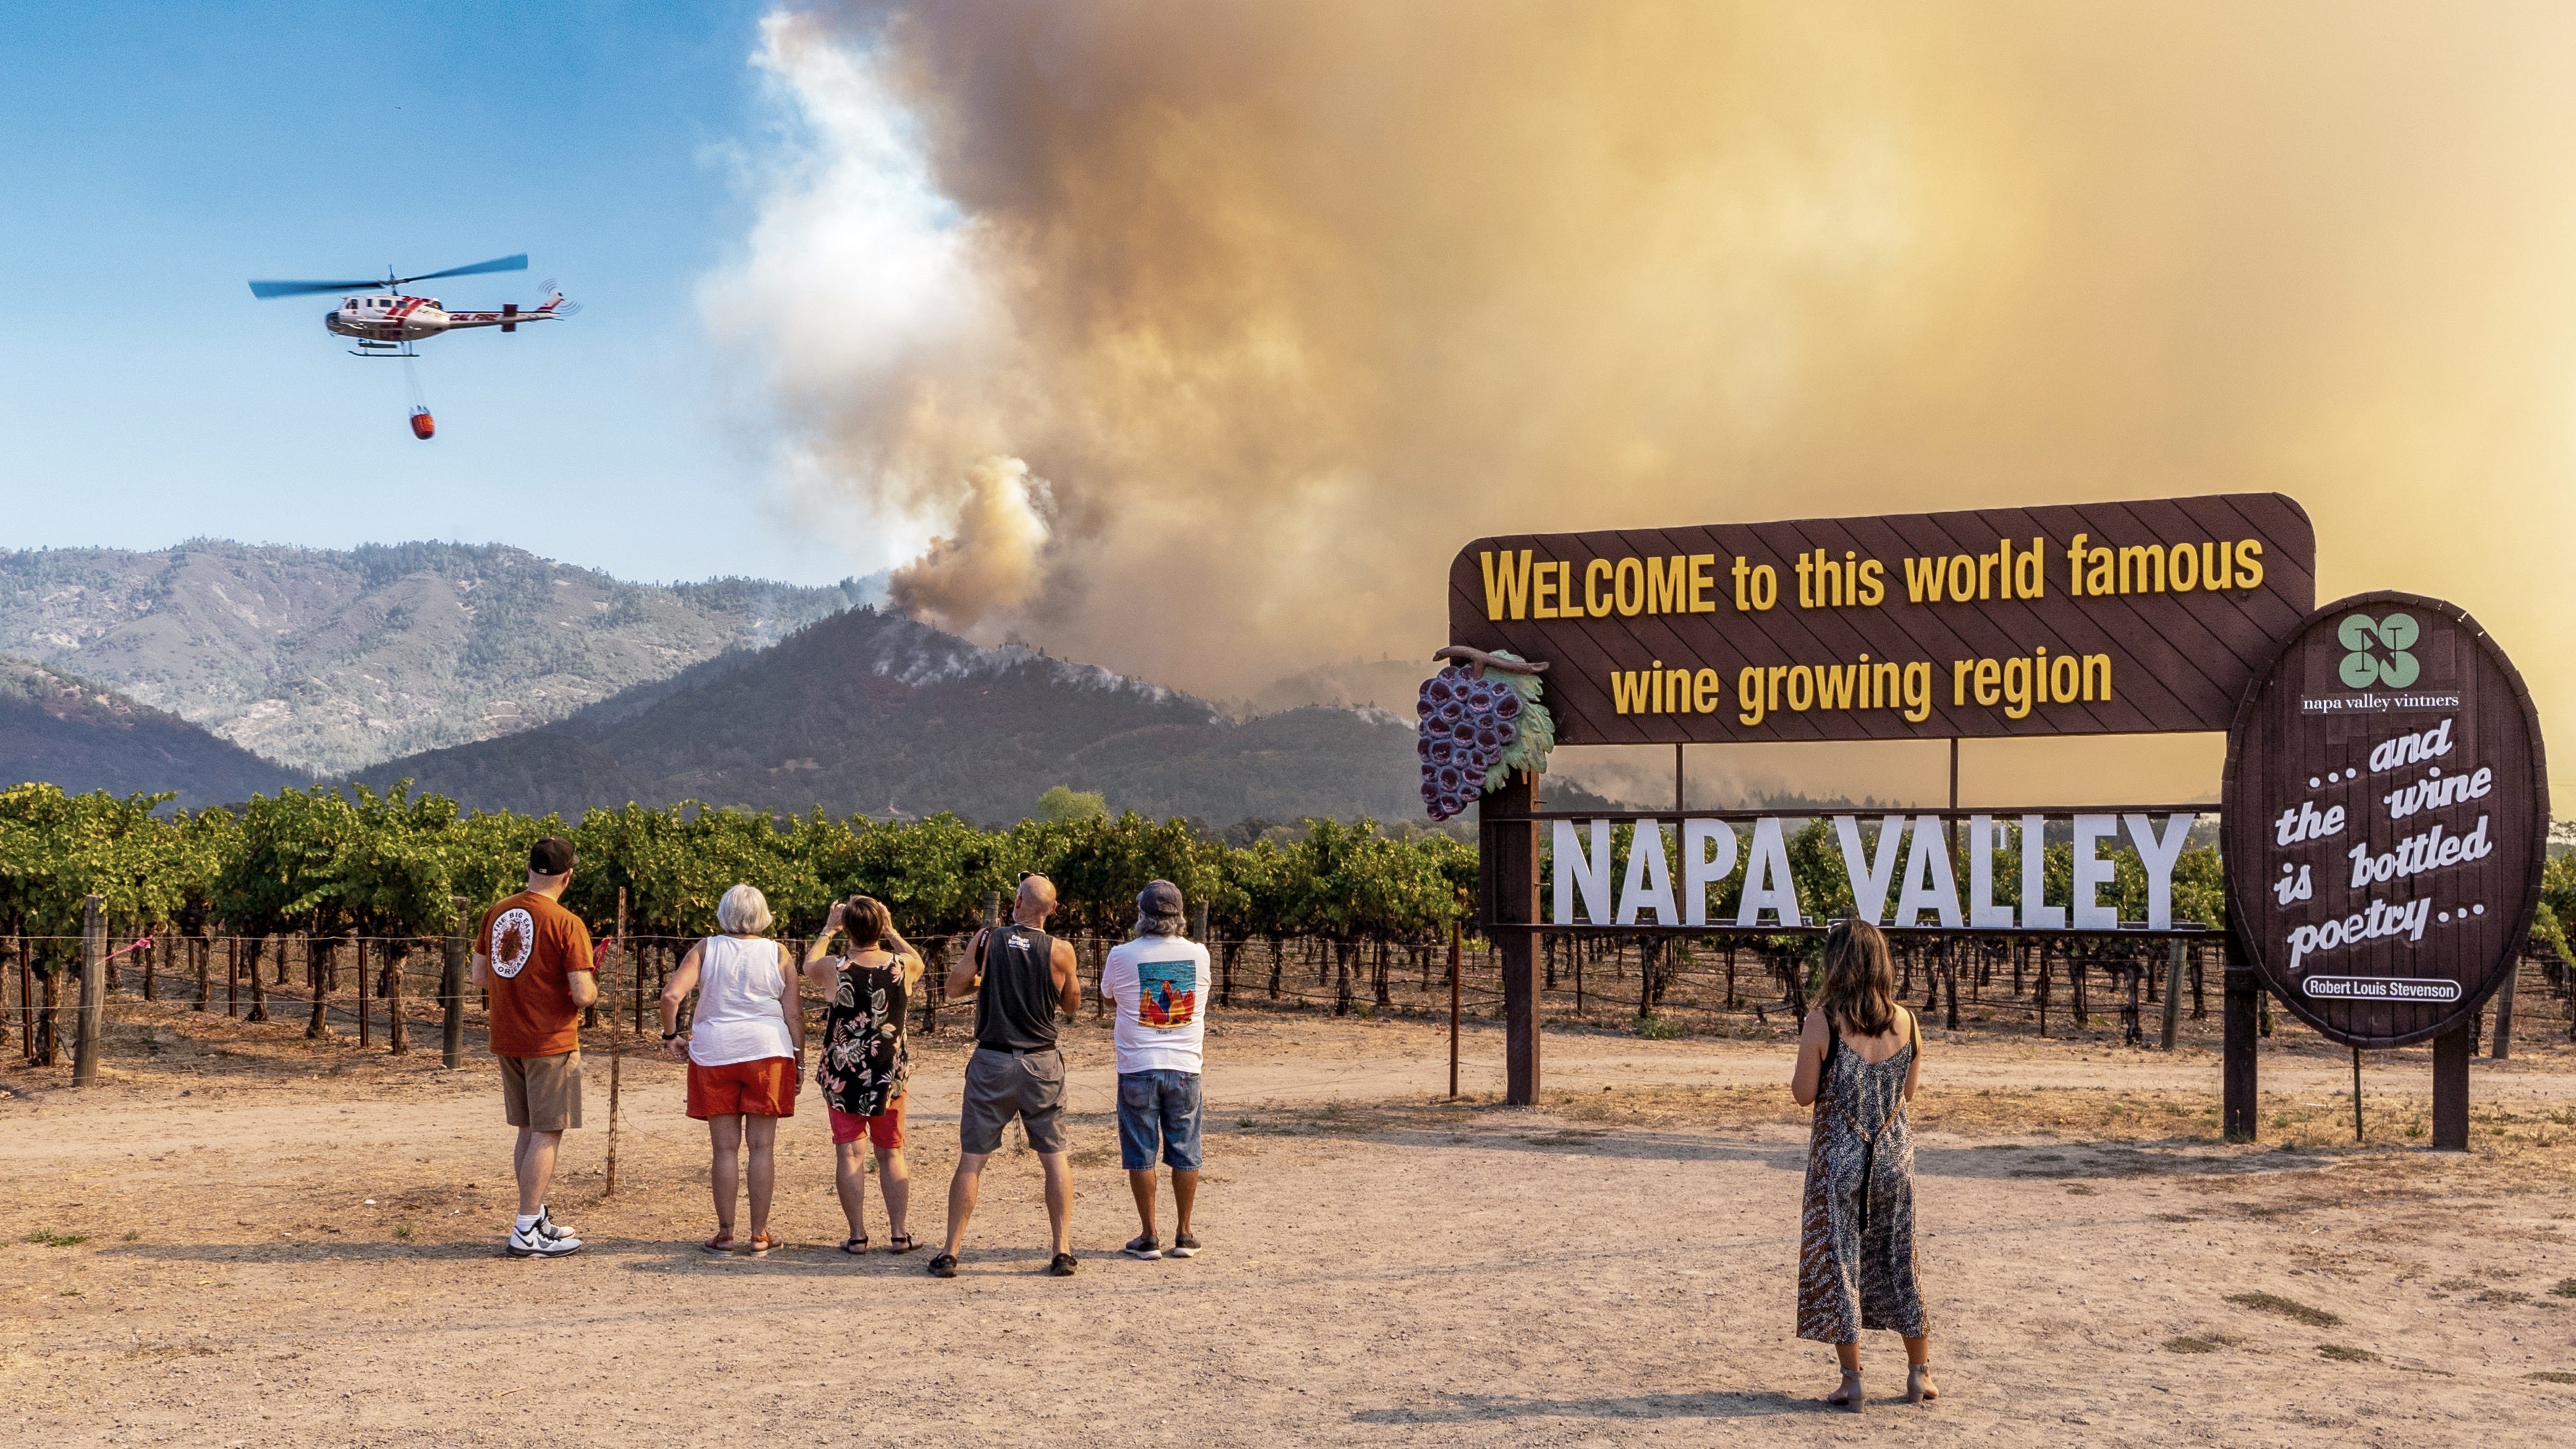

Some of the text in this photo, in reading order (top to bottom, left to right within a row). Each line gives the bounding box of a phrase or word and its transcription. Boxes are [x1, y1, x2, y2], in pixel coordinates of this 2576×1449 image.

[1481, 533, 2263, 620] WELCOME to this world famous
[1611, 647, 2111, 725] wine growing region
[2303, 694, 2459, 713] napa valley vintners
[2276, 767, 2491, 846] the wine
[1553, 814, 2195, 929] NAPA VALLEY
[2274, 815, 2492, 904] is bottled
[494, 916, 507, 932] THE
[497, 950, 528, 975] ORLEANS
[2310, 980, 2454, 997] Robert Louis Stevenson
